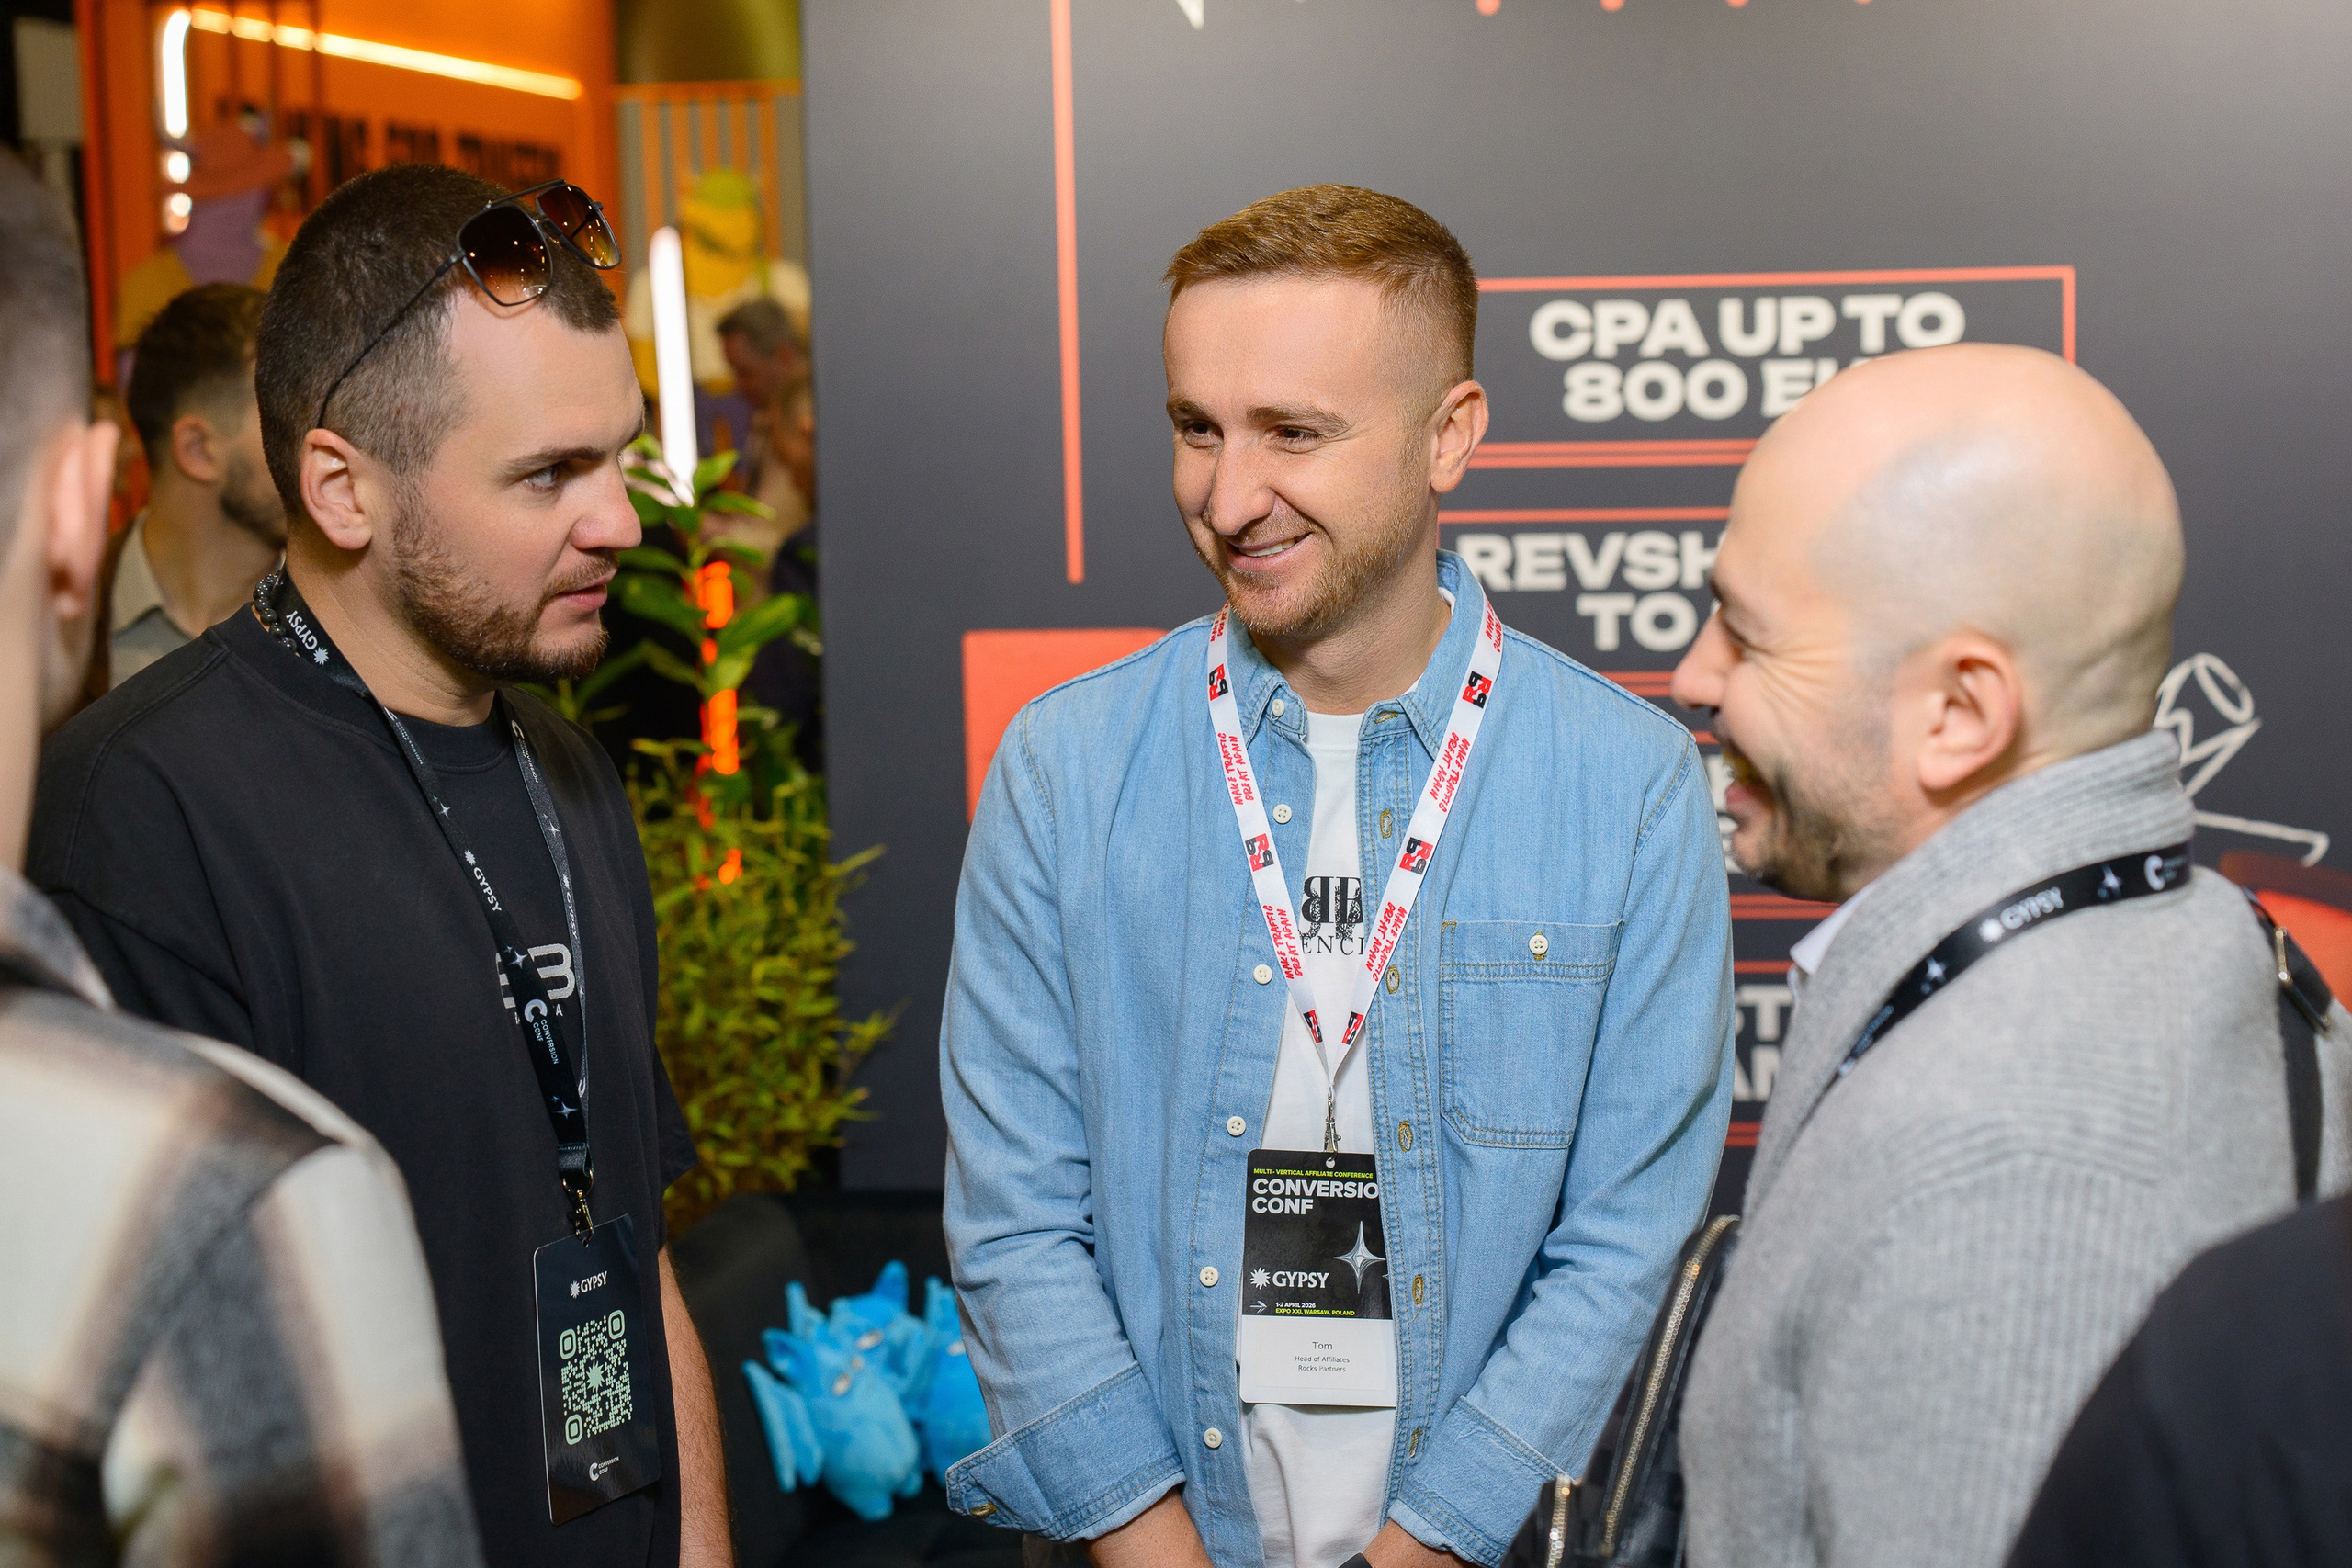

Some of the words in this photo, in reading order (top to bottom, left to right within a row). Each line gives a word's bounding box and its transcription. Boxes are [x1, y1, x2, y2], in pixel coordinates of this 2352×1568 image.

[1529, 299, 1711, 361] CPA
[1717, 295, 1837, 358] UP
[1841, 291, 1967, 354] TO
[1562, 358, 1748, 423] 800
[286, 610, 318, 650] GYPSY
[1575, 591, 1699, 652] TO
[1217, 732, 1235, 774] TRAFFIC
[1229, 735, 1246, 765] AGAIN
[1455, 737, 1470, 770] MAKE
[1227, 776, 1244, 805] MAKE
[1430, 764, 1447, 800] AGAIN
[1438, 769, 1459, 813] TRAFFIC
[473, 866, 503, 913] GYPSY
[1262, 904, 1283, 948] TRAFFIC
[1276, 908, 1295, 940] AGAIN
[1391, 906, 1408, 938] MAKE
[1999, 886, 2064, 930] GYPSY
[1276, 950, 1295, 980] MAKE
[1365, 936, 1382, 972] AGAIN
[1372, 939, 1394, 982] TRAFFIC
[533, 1021, 544, 1043] CONF
[540, 1019, 559, 1065] CONVERSION
[1252, 1178, 1379, 1200] CONVERSIO
[1252, 1196, 1314, 1215] CONF
[581, 1270, 607, 1293] GYPSY
[1272, 1270, 1329, 1289] GYPSY
[1312, 1341, 1333, 1349] Tom
